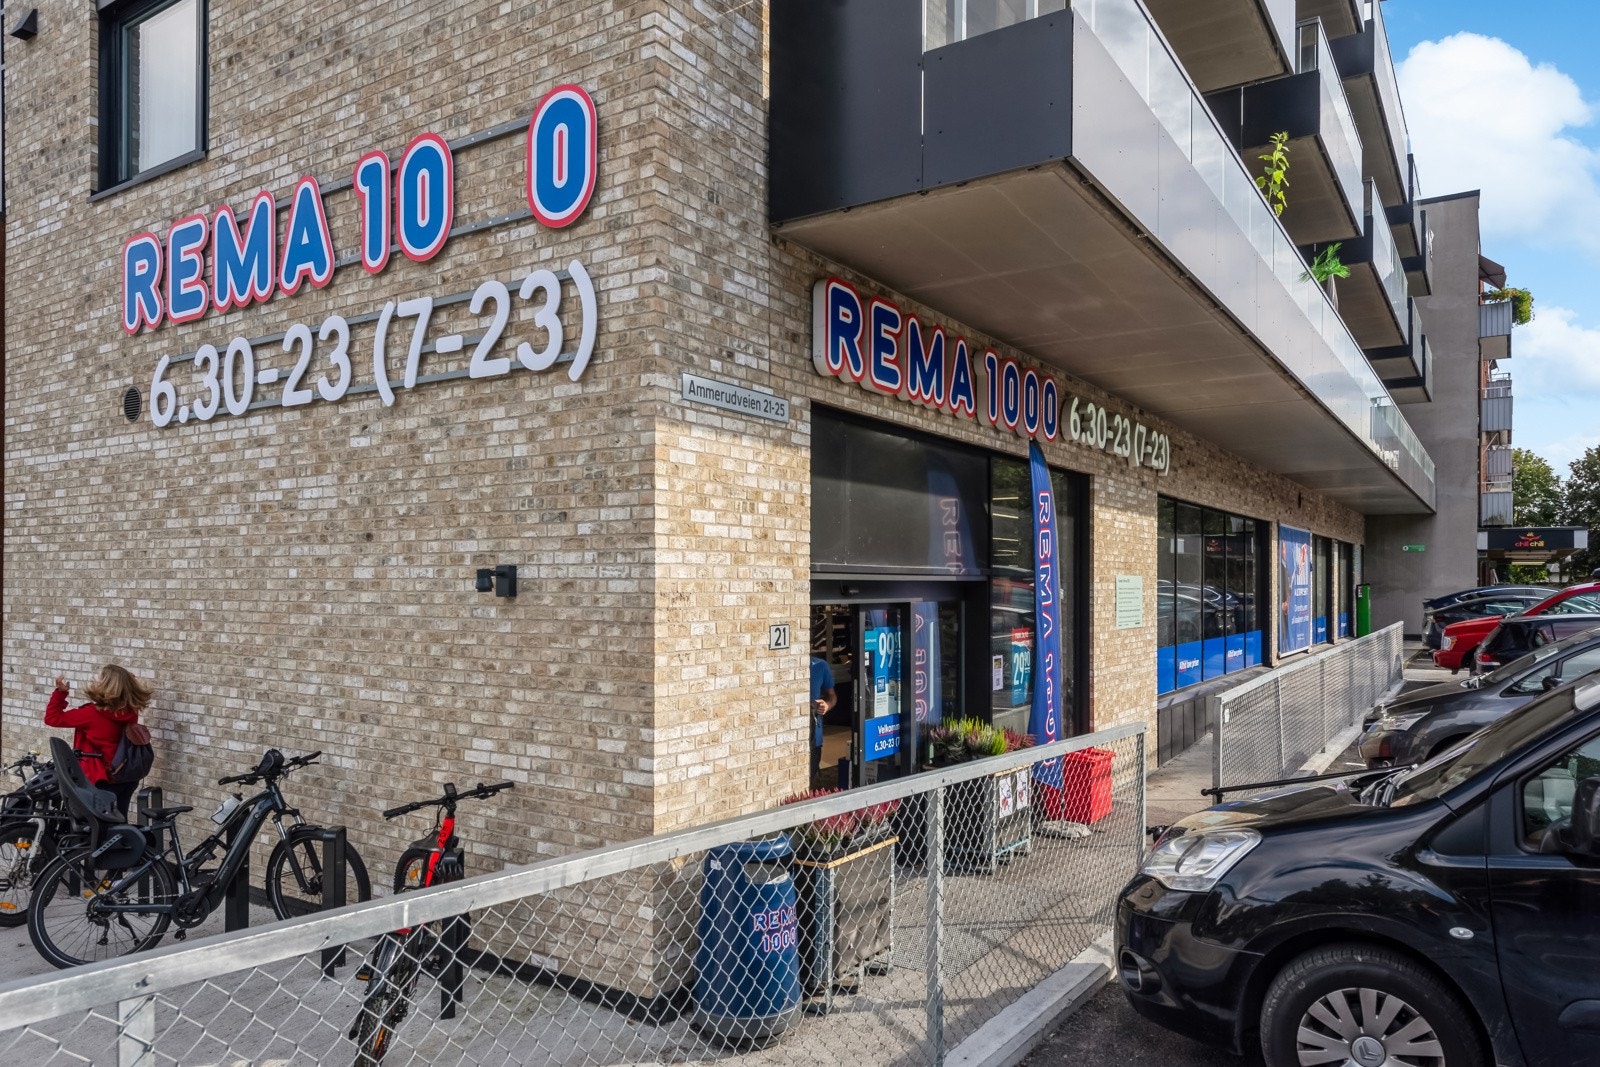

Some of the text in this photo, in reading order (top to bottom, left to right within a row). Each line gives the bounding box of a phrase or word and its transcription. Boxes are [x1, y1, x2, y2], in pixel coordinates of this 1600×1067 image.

[123, 175, 335, 334] REMA
[150, 259, 598, 428] 6.30-23 (7-23)
[825, 276, 1058, 442] REMA 1000
[688, 380, 785, 417] Ammerudveien 21-25
[1069, 396, 1169, 476] 6.30-23 (7-23)
[1039, 490, 1053, 639] REMA
[773, 627, 788, 647] 21
[878, 632, 895, 669] 99
[1013, 652, 1024, 686] 29
